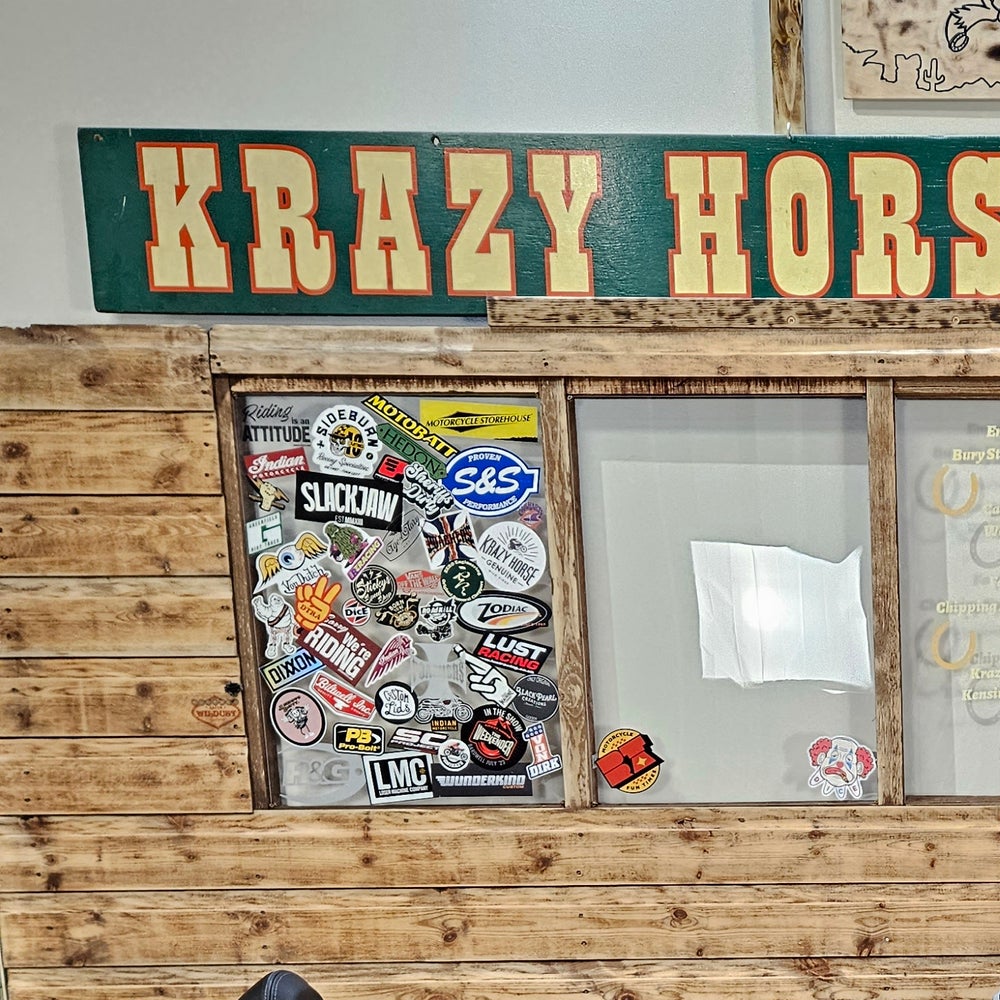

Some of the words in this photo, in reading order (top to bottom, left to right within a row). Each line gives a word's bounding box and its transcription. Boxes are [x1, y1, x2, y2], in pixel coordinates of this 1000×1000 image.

[136, 142, 602, 296] KRAZY
[243, 404, 293, 422] Riding
[426, 417, 478, 427] MOTORCYCLE
[480, 414, 531, 424] STOREHOUSE
[243, 425, 311, 442] ATTITUDE
[316, 409, 378, 448] SIDEBURN
[368, 395, 458, 458] MOTOBATT
[383, 428, 441, 475] HEDON
[468, 453, 502, 462] PROVEN
[952, 448, 985, 464] Bury
[986, 448, 1000, 460] St
[248, 455, 305, 474] Indian
[452, 466, 522, 495] S&S
[301, 482, 399, 522] SLACKJAW
[403, 483, 441, 515] Dirty
[463, 496, 517, 510] PERFORMANCE
[479, 534, 512, 563] KRAZY
[508, 556, 540, 586] HORSE
[486, 559, 518, 584] GENUINE
[281, 580, 299, 593] Von
[297, 565, 325, 586] Dutch
[300, 604, 321, 621] DTRA
[477, 603, 529, 623] ZODIAC
[936, 601, 997, 616] Chipping
[304, 627, 365, 680] RIDING
[343, 631, 372, 660] We're
[483, 633, 547, 659] LUST
[268, 651, 317, 684] DIXXON
[478, 647, 540, 671] RACING
[316, 677, 356, 704] Biltwell
[383, 688, 409, 702] CUSTOM
[385, 701, 411, 716] Lids
[483, 708, 491, 716] IN
[493, 708, 506, 717] THE
[506, 713, 523, 732] SHOW
[338, 743, 377, 751] Pro-Bolt
[345, 728, 372, 743] PB
[392, 728, 449, 746] SC
[472, 724, 515, 757] WEEKENDER
[602, 732, 634, 753] MOTORCYCLE
[373, 757, 427, 790] LMC
[529, 757, 560, 778] DIRK
[435, 775, 526, 787] WUNDERKIND
